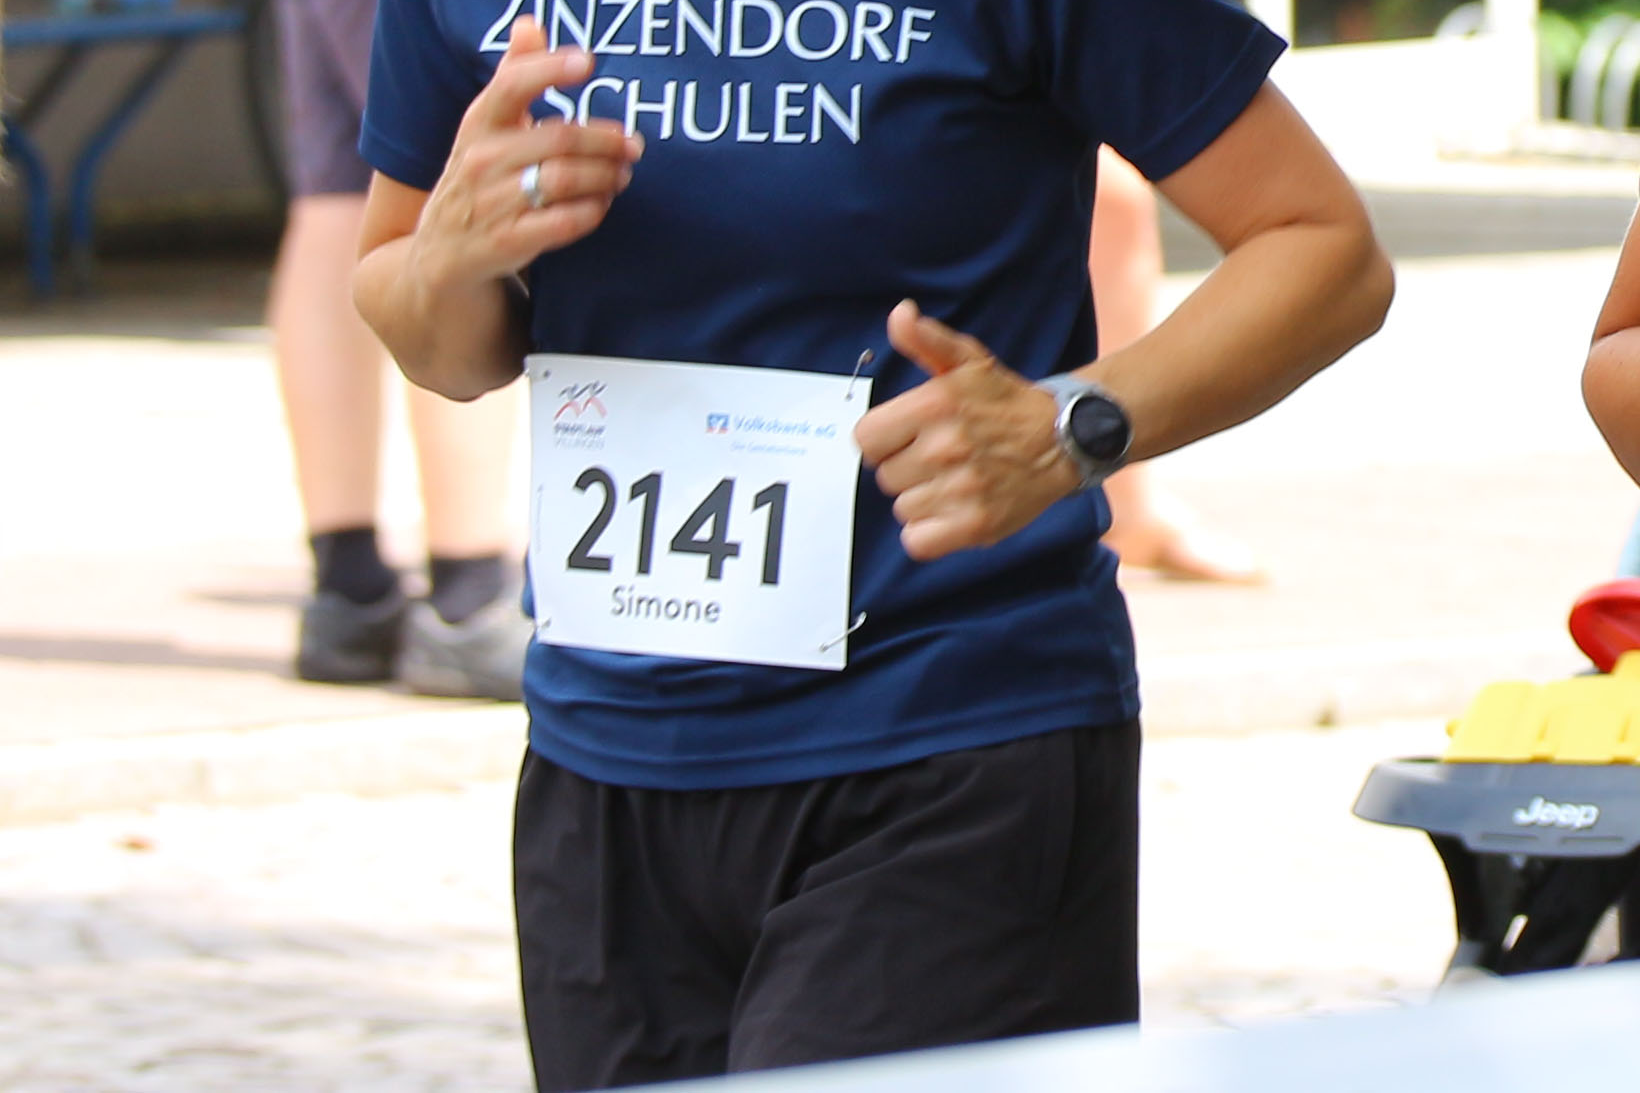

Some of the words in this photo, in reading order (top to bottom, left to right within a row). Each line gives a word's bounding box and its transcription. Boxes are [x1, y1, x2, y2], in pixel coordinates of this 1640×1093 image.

[566, 466, 790, 586] 2141
[611, 585, 721, 624] Simone
[1514, 796, 1600, 830] Jeep
